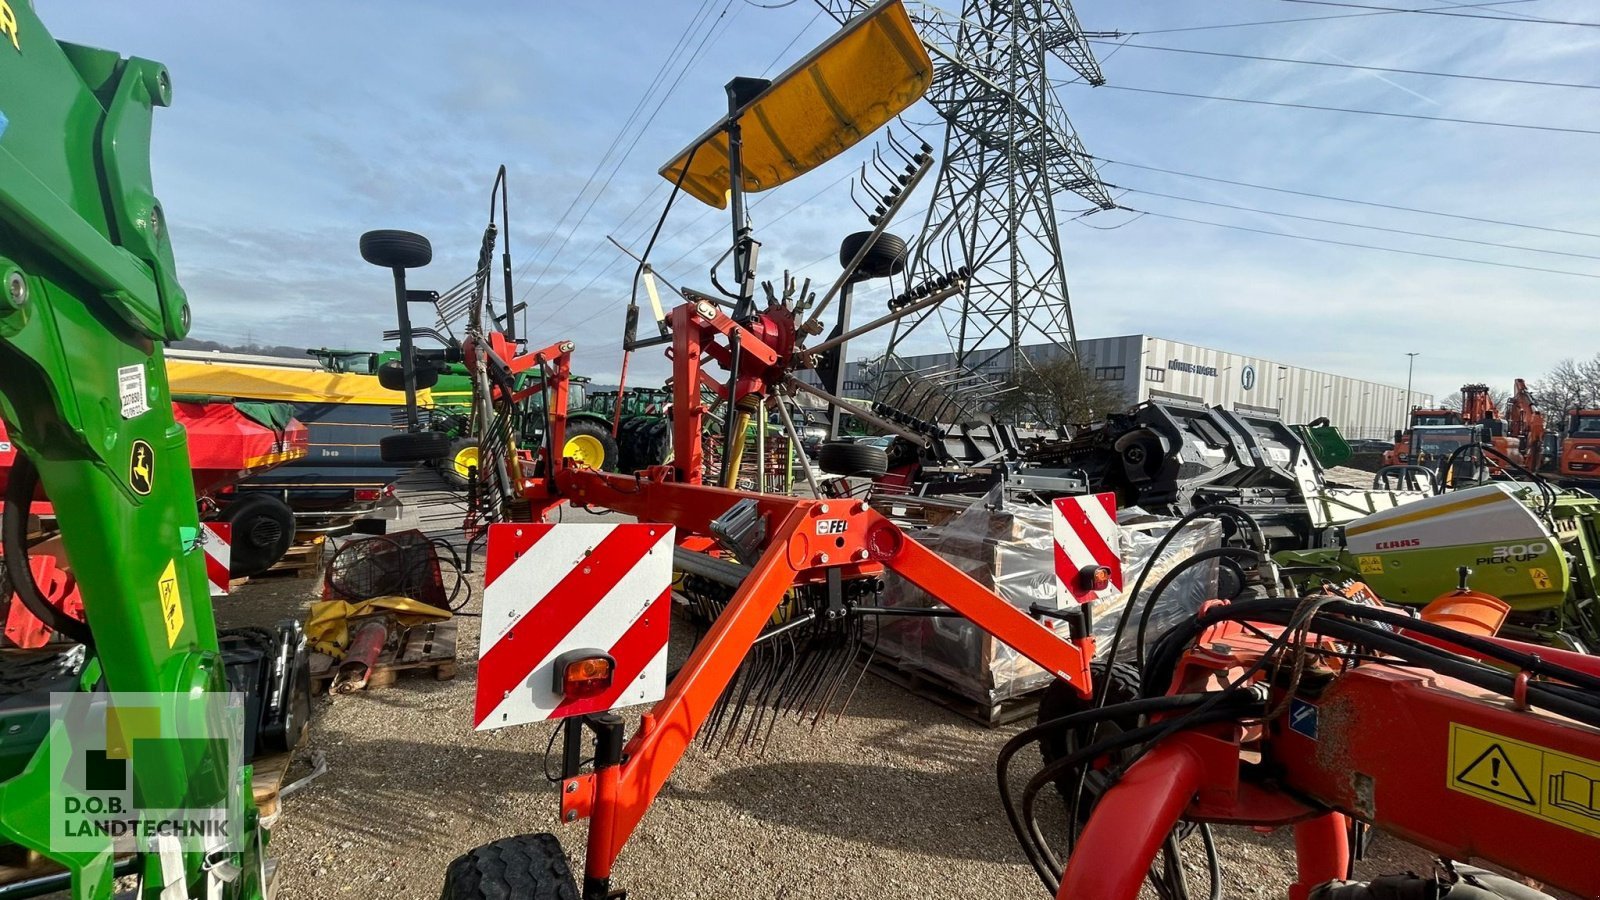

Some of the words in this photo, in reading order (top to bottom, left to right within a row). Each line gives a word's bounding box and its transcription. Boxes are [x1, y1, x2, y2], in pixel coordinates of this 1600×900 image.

[1375, 538, 1420, 550] CLAAS
[1492, 542, 1548, 558] 300
[1476, 554, 1510, 566] PICK
[1515, 553, 1539, 562] UP
